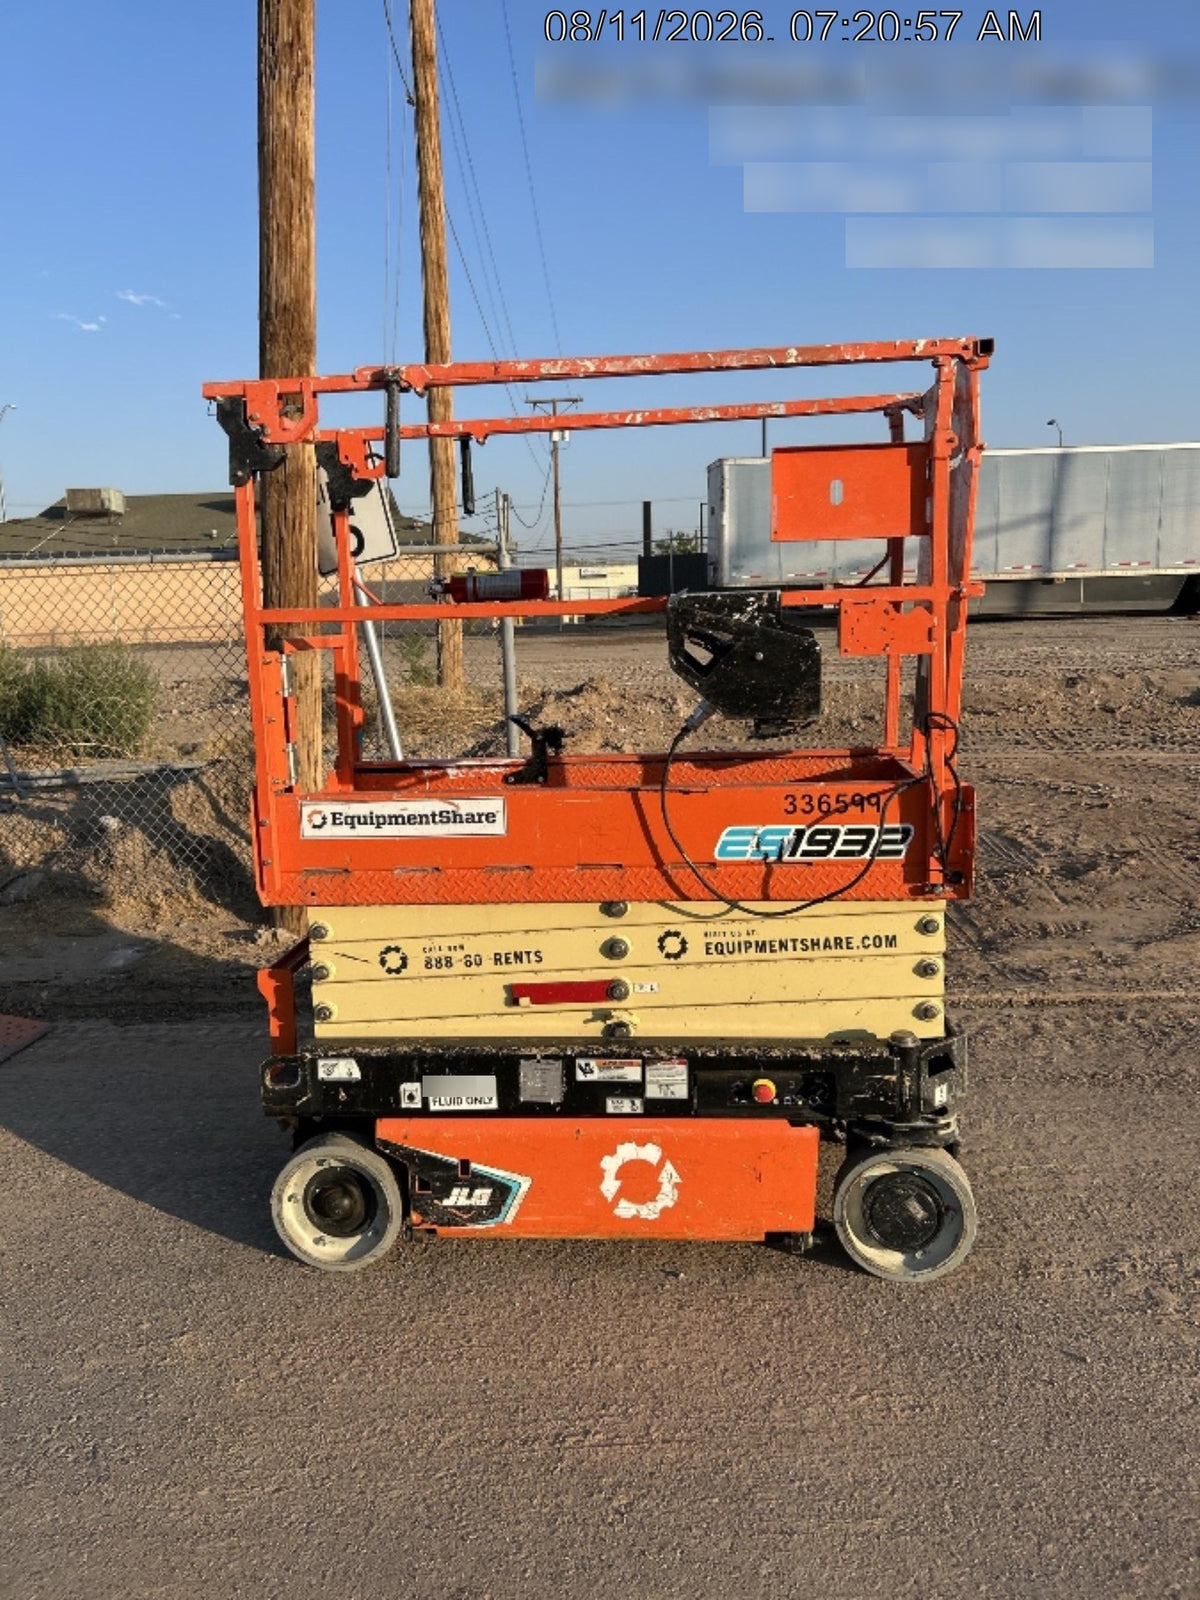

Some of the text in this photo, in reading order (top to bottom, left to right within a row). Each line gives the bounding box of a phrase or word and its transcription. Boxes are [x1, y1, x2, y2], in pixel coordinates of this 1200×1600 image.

[783, 793, 882, 815] 336599
[330, 809, 497, 829] EquipmentShare
[714, 824, 915, 860] ES1932
[704, 934, 898, 956] EQUIPMENTSHARE.COM
[432, 1096, 494, 1107] FLUID ONLY
[442, 1187, 493, 1206] JLG
